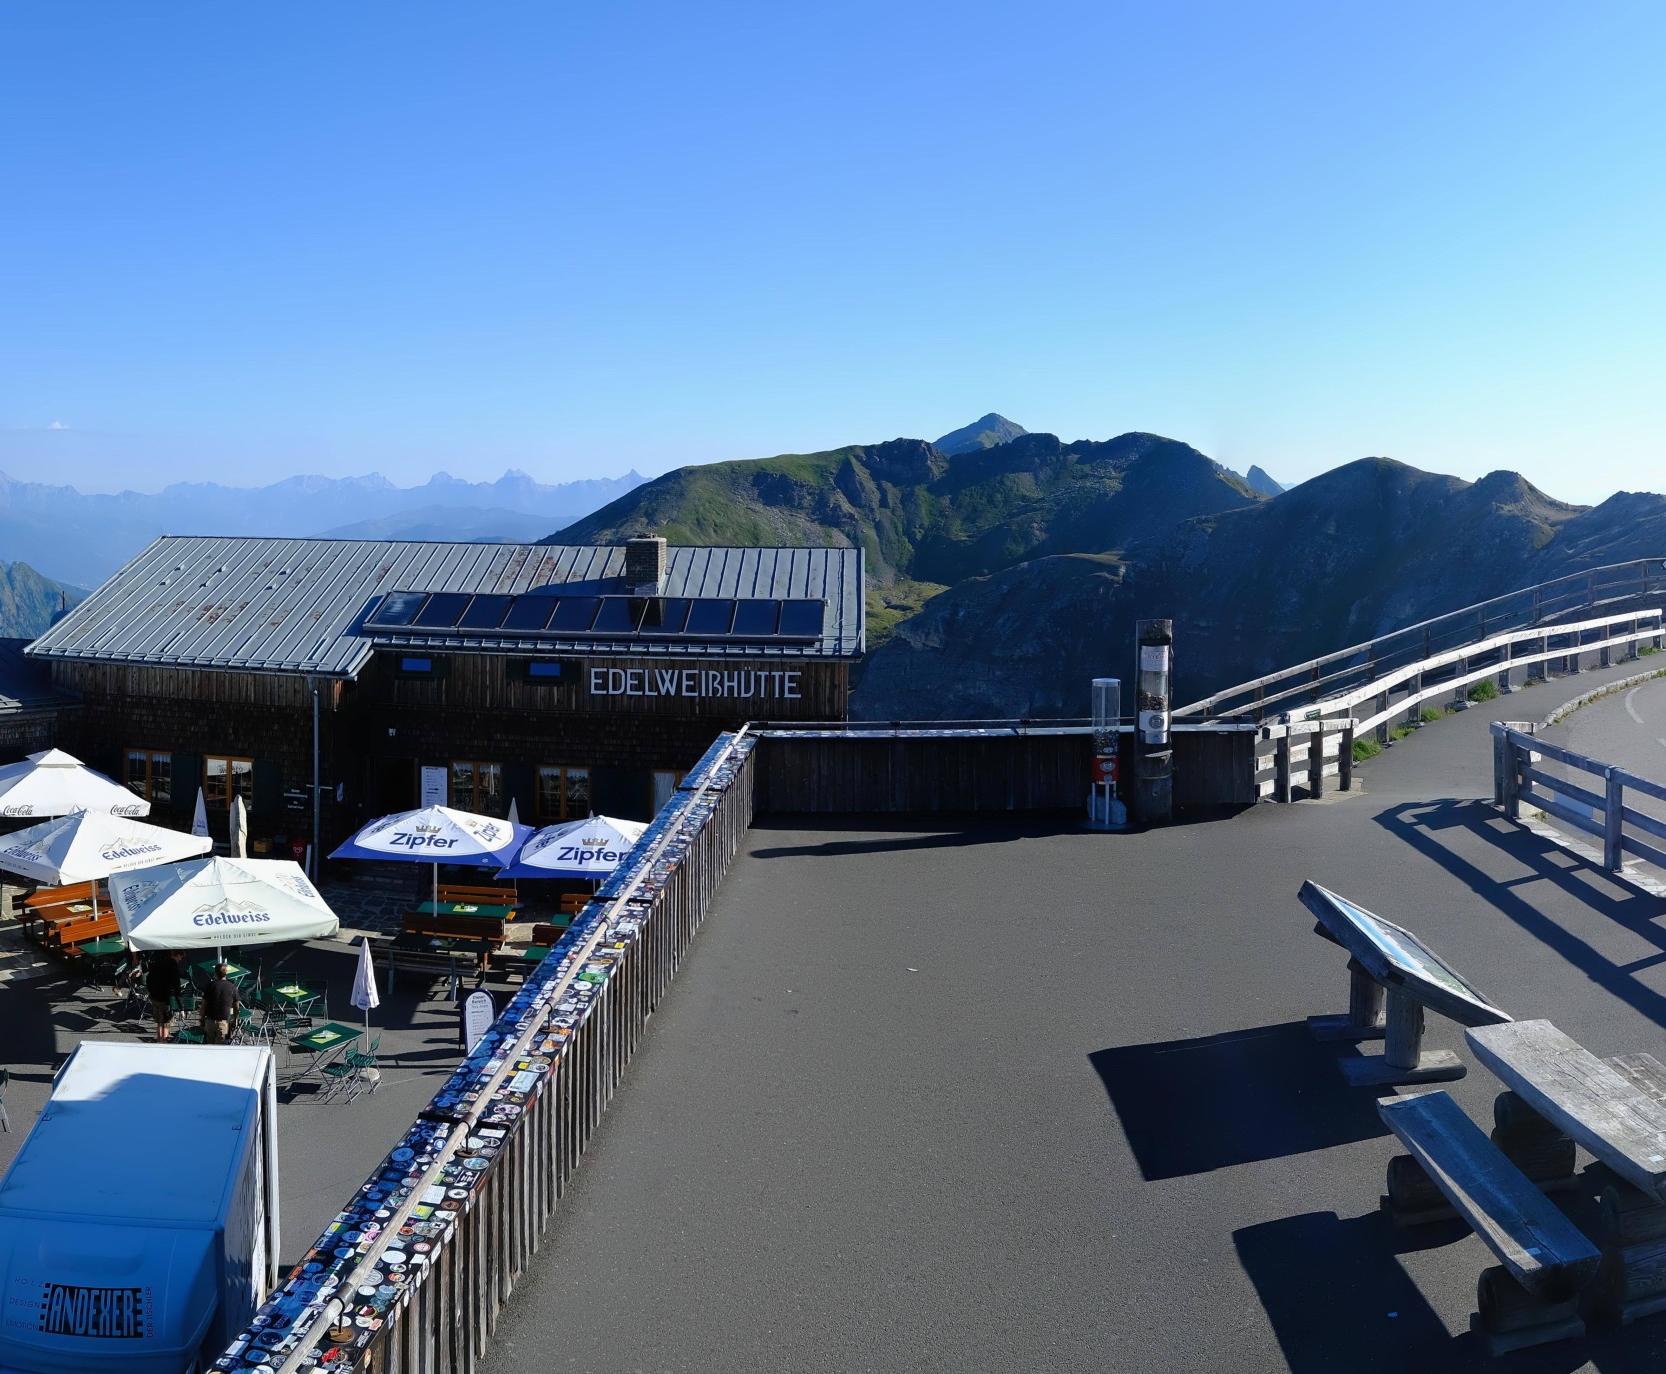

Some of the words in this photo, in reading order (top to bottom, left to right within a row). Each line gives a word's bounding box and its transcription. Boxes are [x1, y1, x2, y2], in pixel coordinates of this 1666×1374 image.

[389, 832, 459, 850] Zipfer
[101, 843, 162, 861] Edelweiss
[556, 846, 629, 865] Zipfer
[193, 911, 271, 927] Edelweiss
[9, 1297, 41, 1309] DESIGN
[48, 1286, 134, 1337] ANDEXER
[5, 1319, 39, 1331] EMOTION
[146, 1323, 154, 1338] DER
